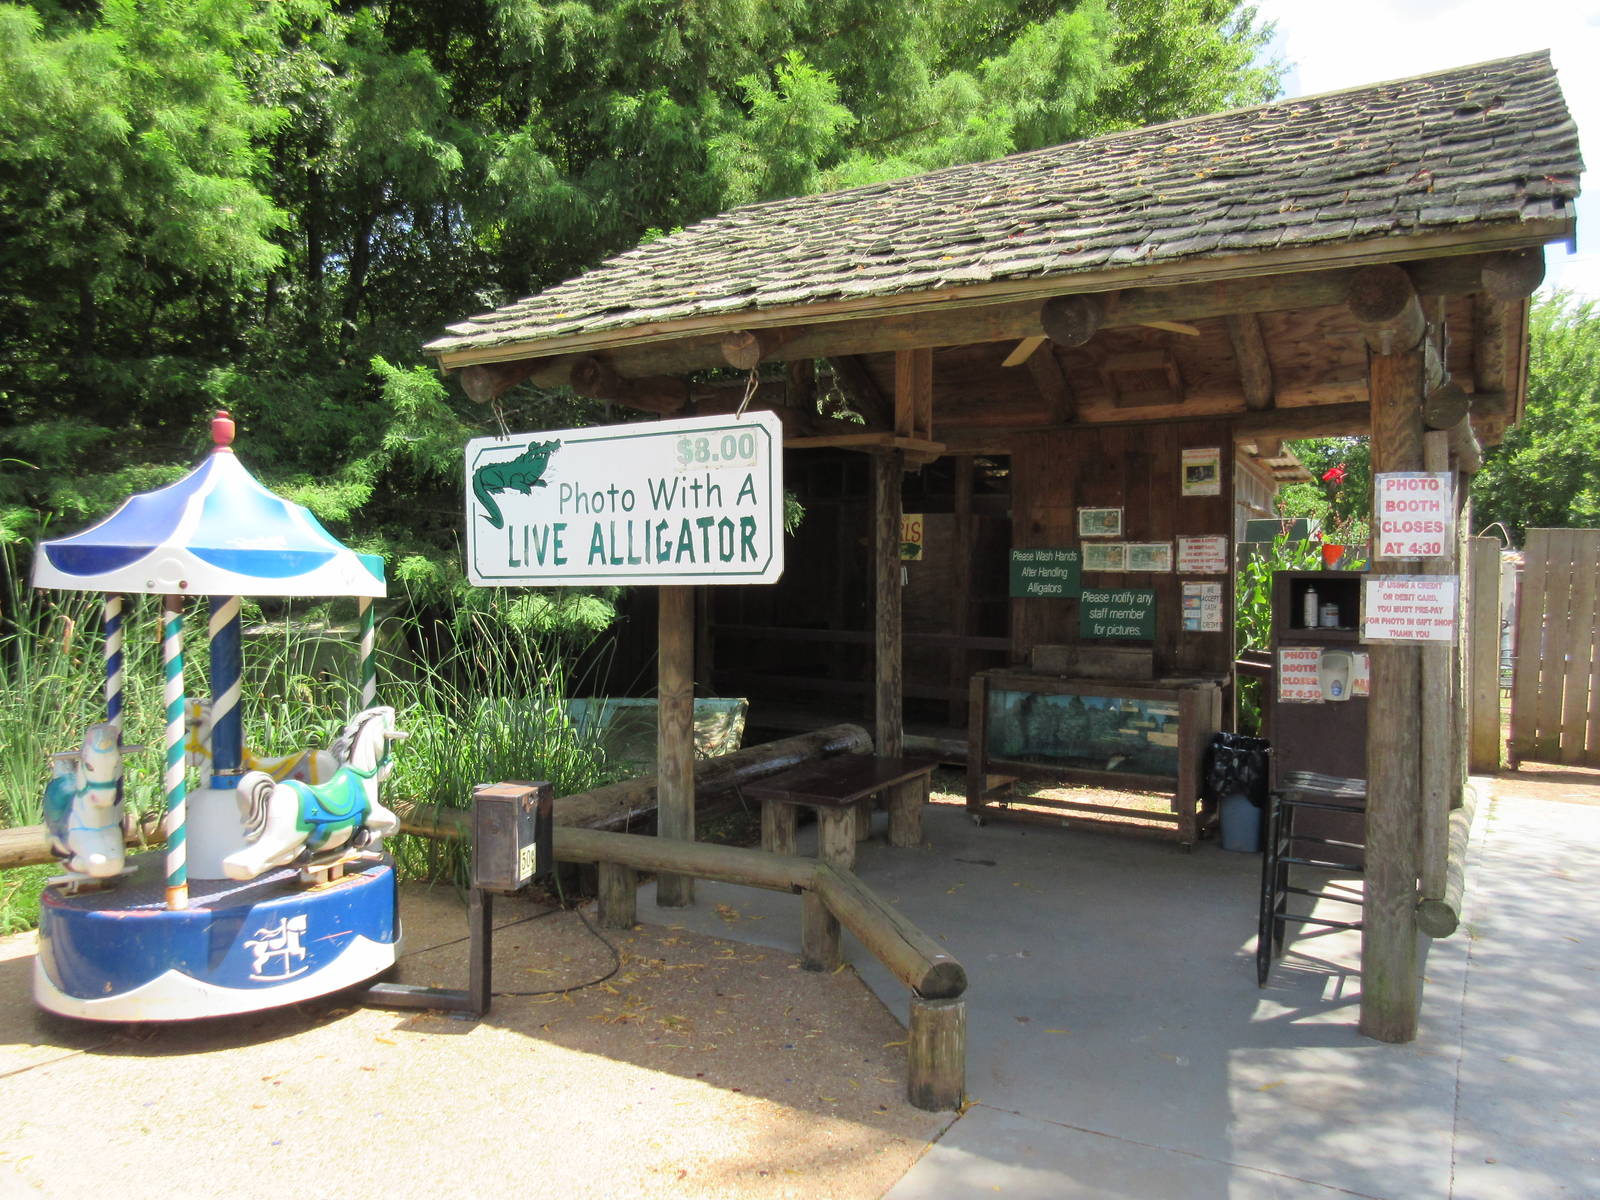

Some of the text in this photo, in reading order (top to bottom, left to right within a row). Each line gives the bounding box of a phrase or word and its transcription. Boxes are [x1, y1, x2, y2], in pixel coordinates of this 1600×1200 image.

[677, 434, 755, 464] $8.00
[1386, 479, 1439, 491] PHOTO
[559, 473, 757, 514] Photo With A
[1385, 500, 1440, 512] BOOTH
[1382, 521, 1443, 533] CLOSES
[508, 515, 758, 568] LIVE ALLIGATOR
[1384, 542, 1441, 554] AT 4:30
[1012, 550, 1078, 562] Please Wash Hands
[1021, 567, 1068, 580] After Handling
[1027, 582, 1062, 595] Alligators
[1387, 581, 1409, 589] USING
[1417, 582, 1443, 590] CREDIT
[1082, 592, 1153, 606] Please notify any
[1089, 608, 1145, 619] staff member
[1415, 606, 1444, 614] PRE-PAY
[1381, 617, 1405, 625] PHOTO
[1093, 624, 1141, 636] for pictures.
[1389, 629, 1430, 638] THANK YOU
[1284, 652, 1318, 660] PHOTO
[1282, 664, 1317, 672] BOOTH
[1281, 689, 1293, 697] AT
